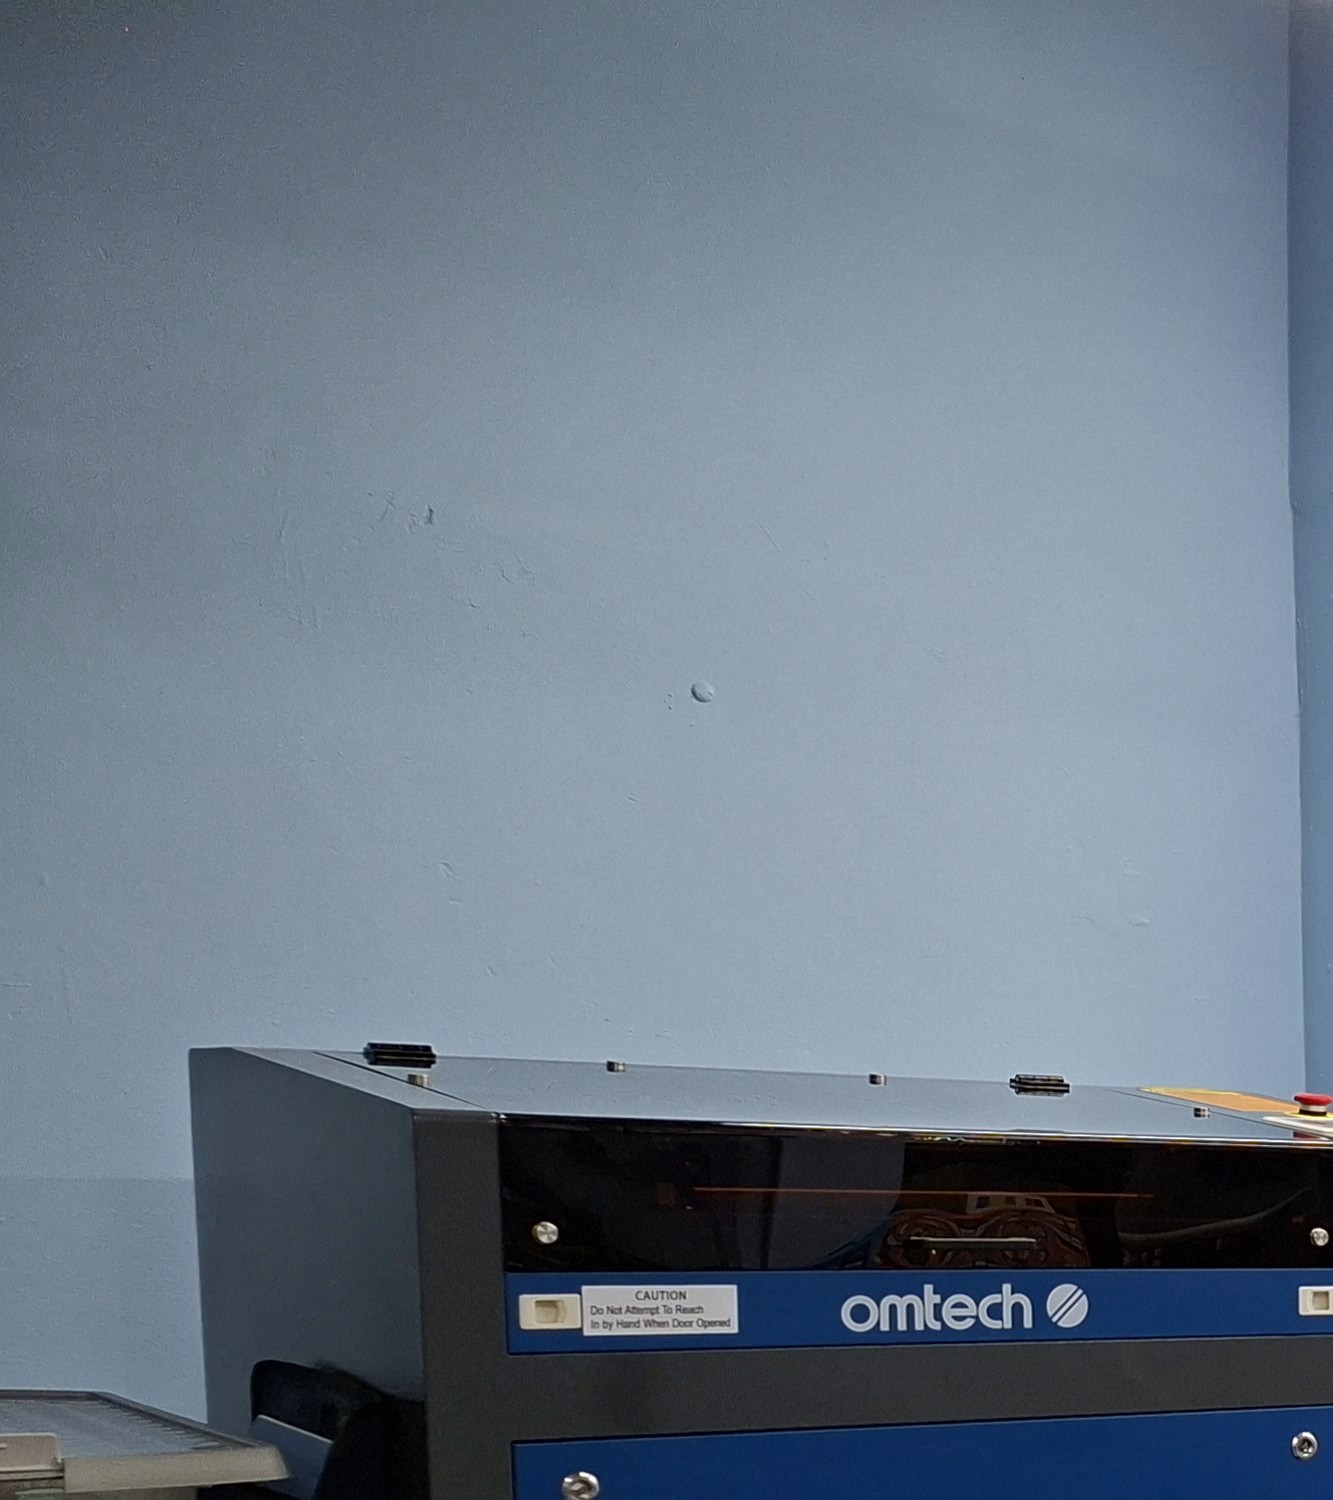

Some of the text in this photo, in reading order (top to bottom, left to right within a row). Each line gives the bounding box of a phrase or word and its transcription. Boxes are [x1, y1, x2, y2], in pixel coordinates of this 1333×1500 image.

[635, 1290, 687, 1302] CAUTION
[590, 1304, 705, 1316] Do Not Attempt To Reach
[841, 1283, 1033, 1333] omtech
[590, 1318, 731, 1330] In by Hand When Door Opened
